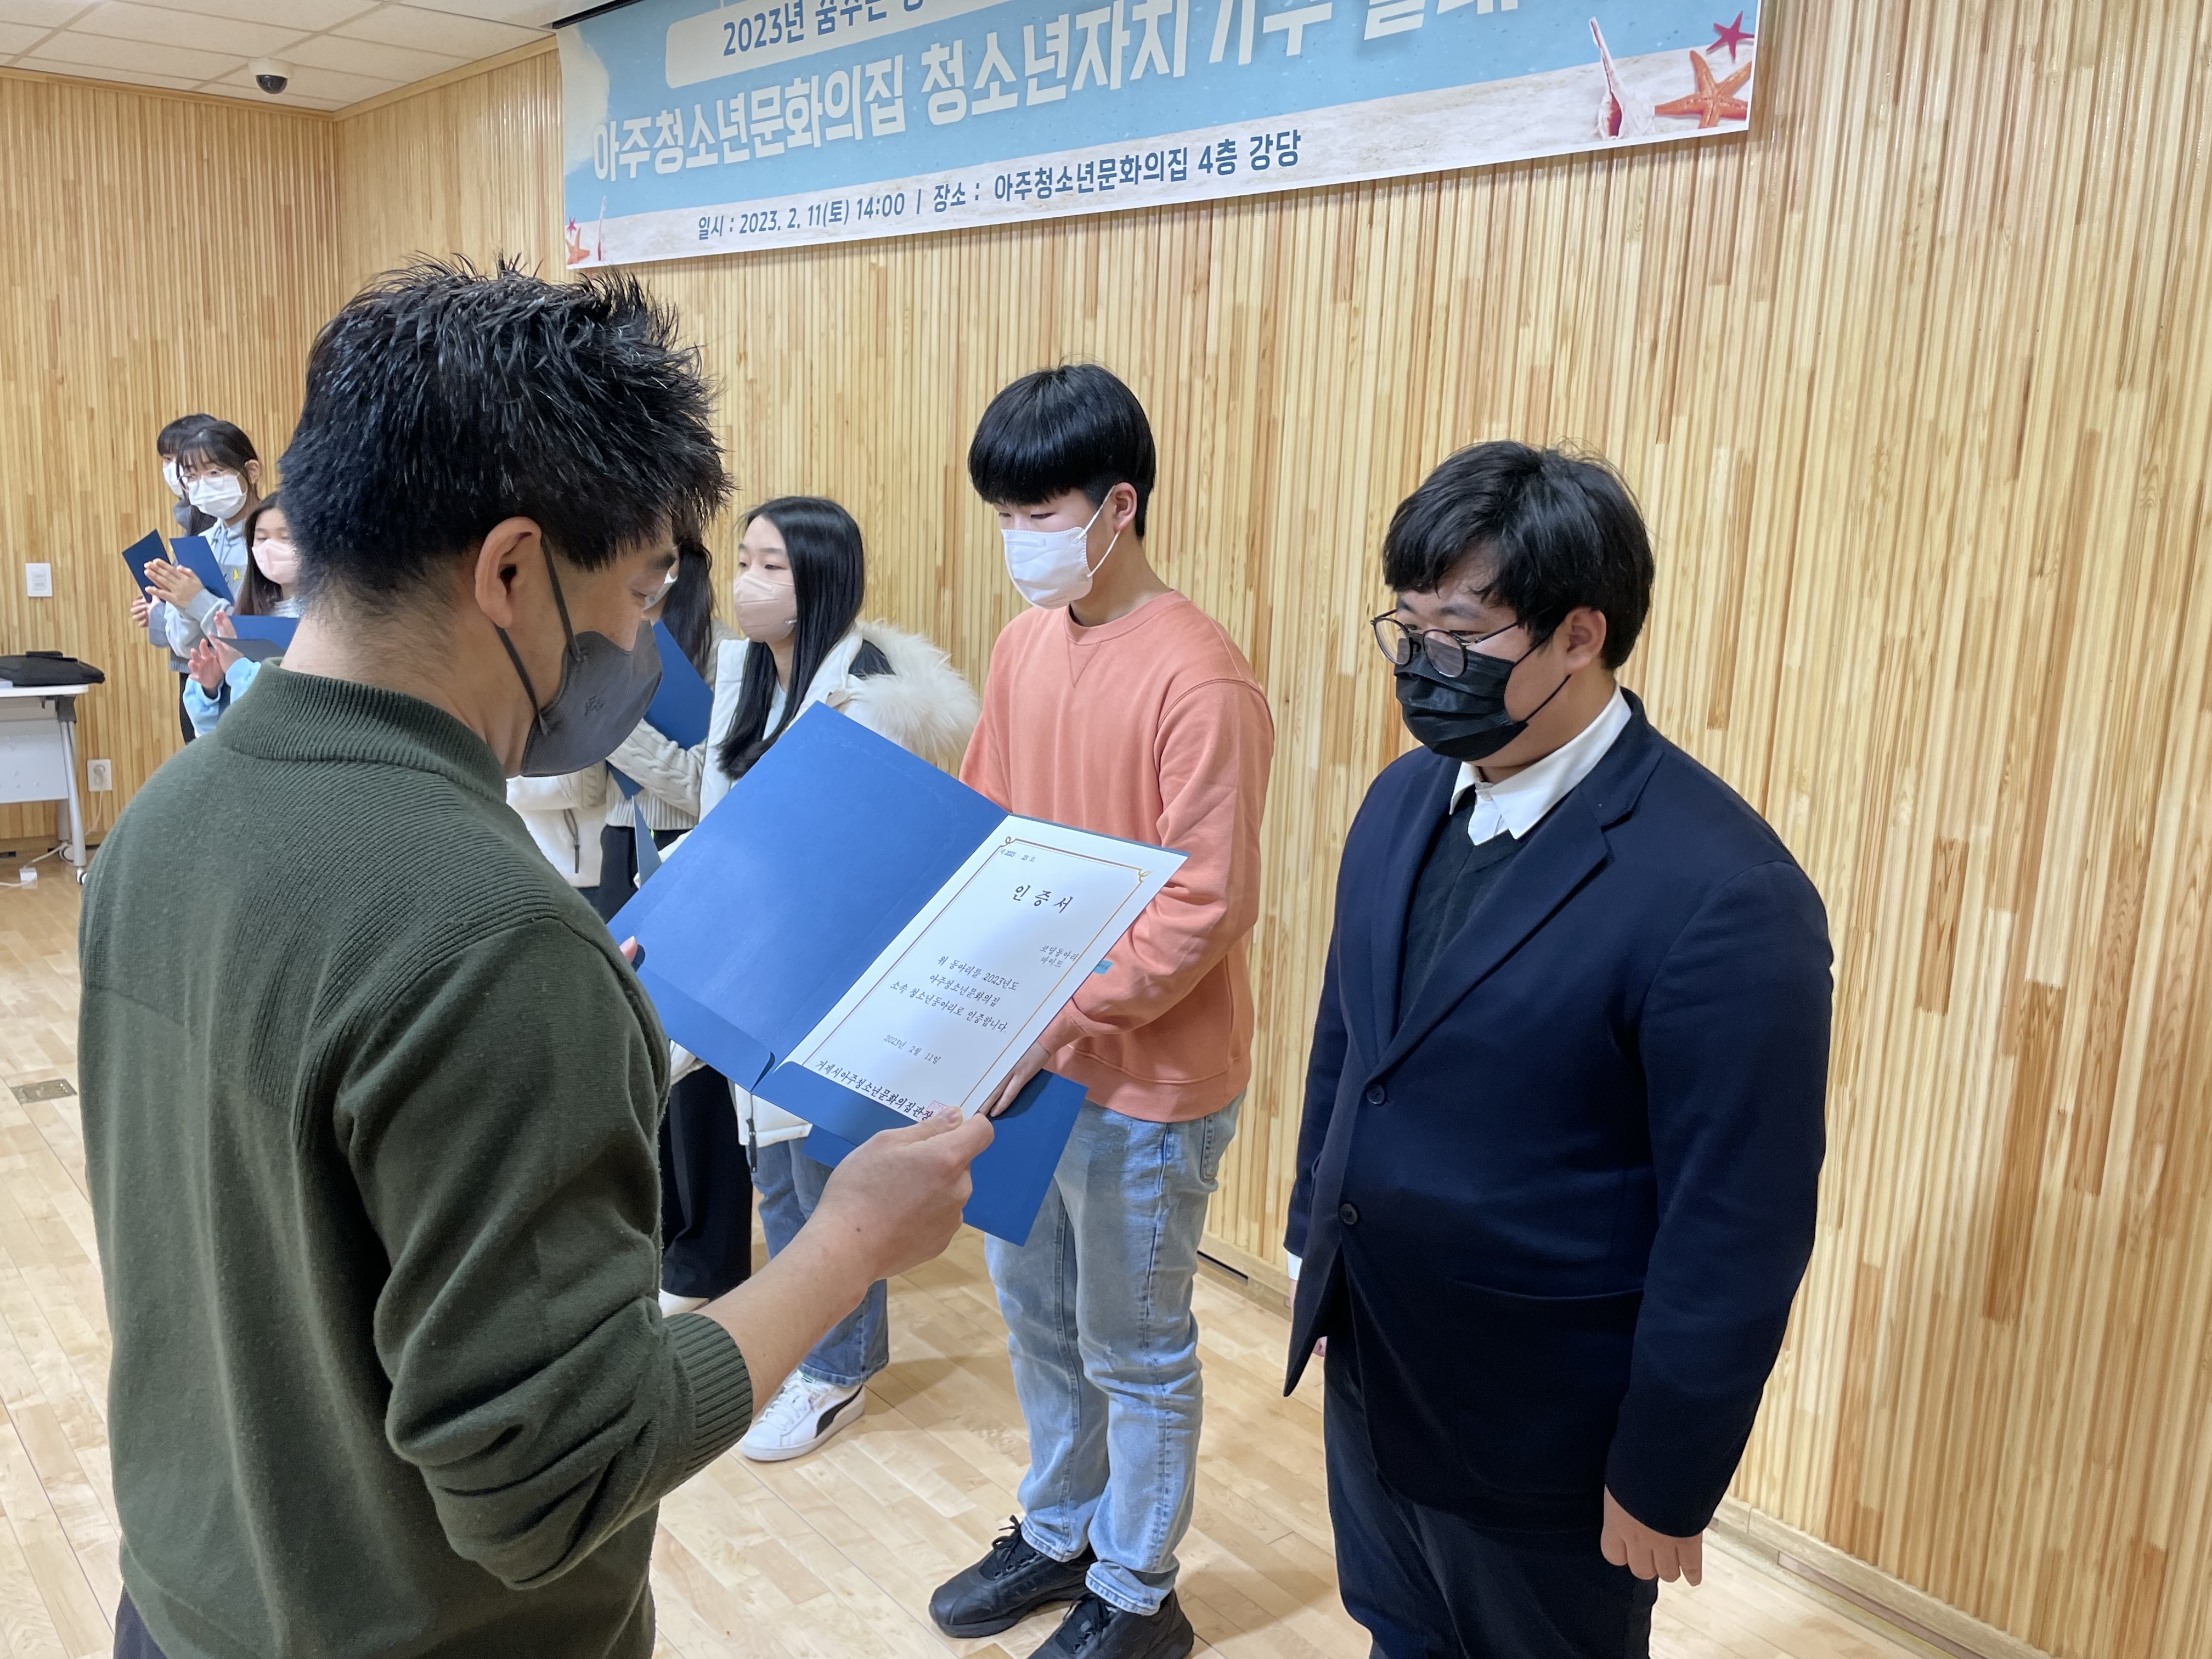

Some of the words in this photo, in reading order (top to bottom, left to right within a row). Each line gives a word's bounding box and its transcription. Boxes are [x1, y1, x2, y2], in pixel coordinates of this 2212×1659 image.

[724, 0, 804, 56] 2023년
[593, 55, 906, 182] 아주청소년문화의집
[698, 216, 723, 240] 일시
[739, 210, 781, 234] 2023.
[787, 208, 800, 229] 2.
[808, 199, 849, 227] 11(토)
[857, 193, 905, 220] 14:00
[934, 182, 966, 213] 장소
[994, 147, 1187, 201] 아주청소년문화의집
[1198, 138, 1238, 176] 4층
[1250, 129, 1301, 171] 강당
[1040, 945, 1079, 961] 코딩동아리
[1040, 956, 1063, 968] 바이트
[930, 974, 1000, 1007] 아주청소년문화의집
[938, 956, 949, 966] 위
[949, 960, 982, 978] 동아리를
[982, 973, 1019, 991] 2023년도
[890, 981, 909, 994] 소속
[909, 988, 964, 1016] 청소년동아리로
[883, 1035, 907, 1049] 2023년
[909, 1046, 922, 1056] 2월
[924, 1053, 941, 1065] 11일
